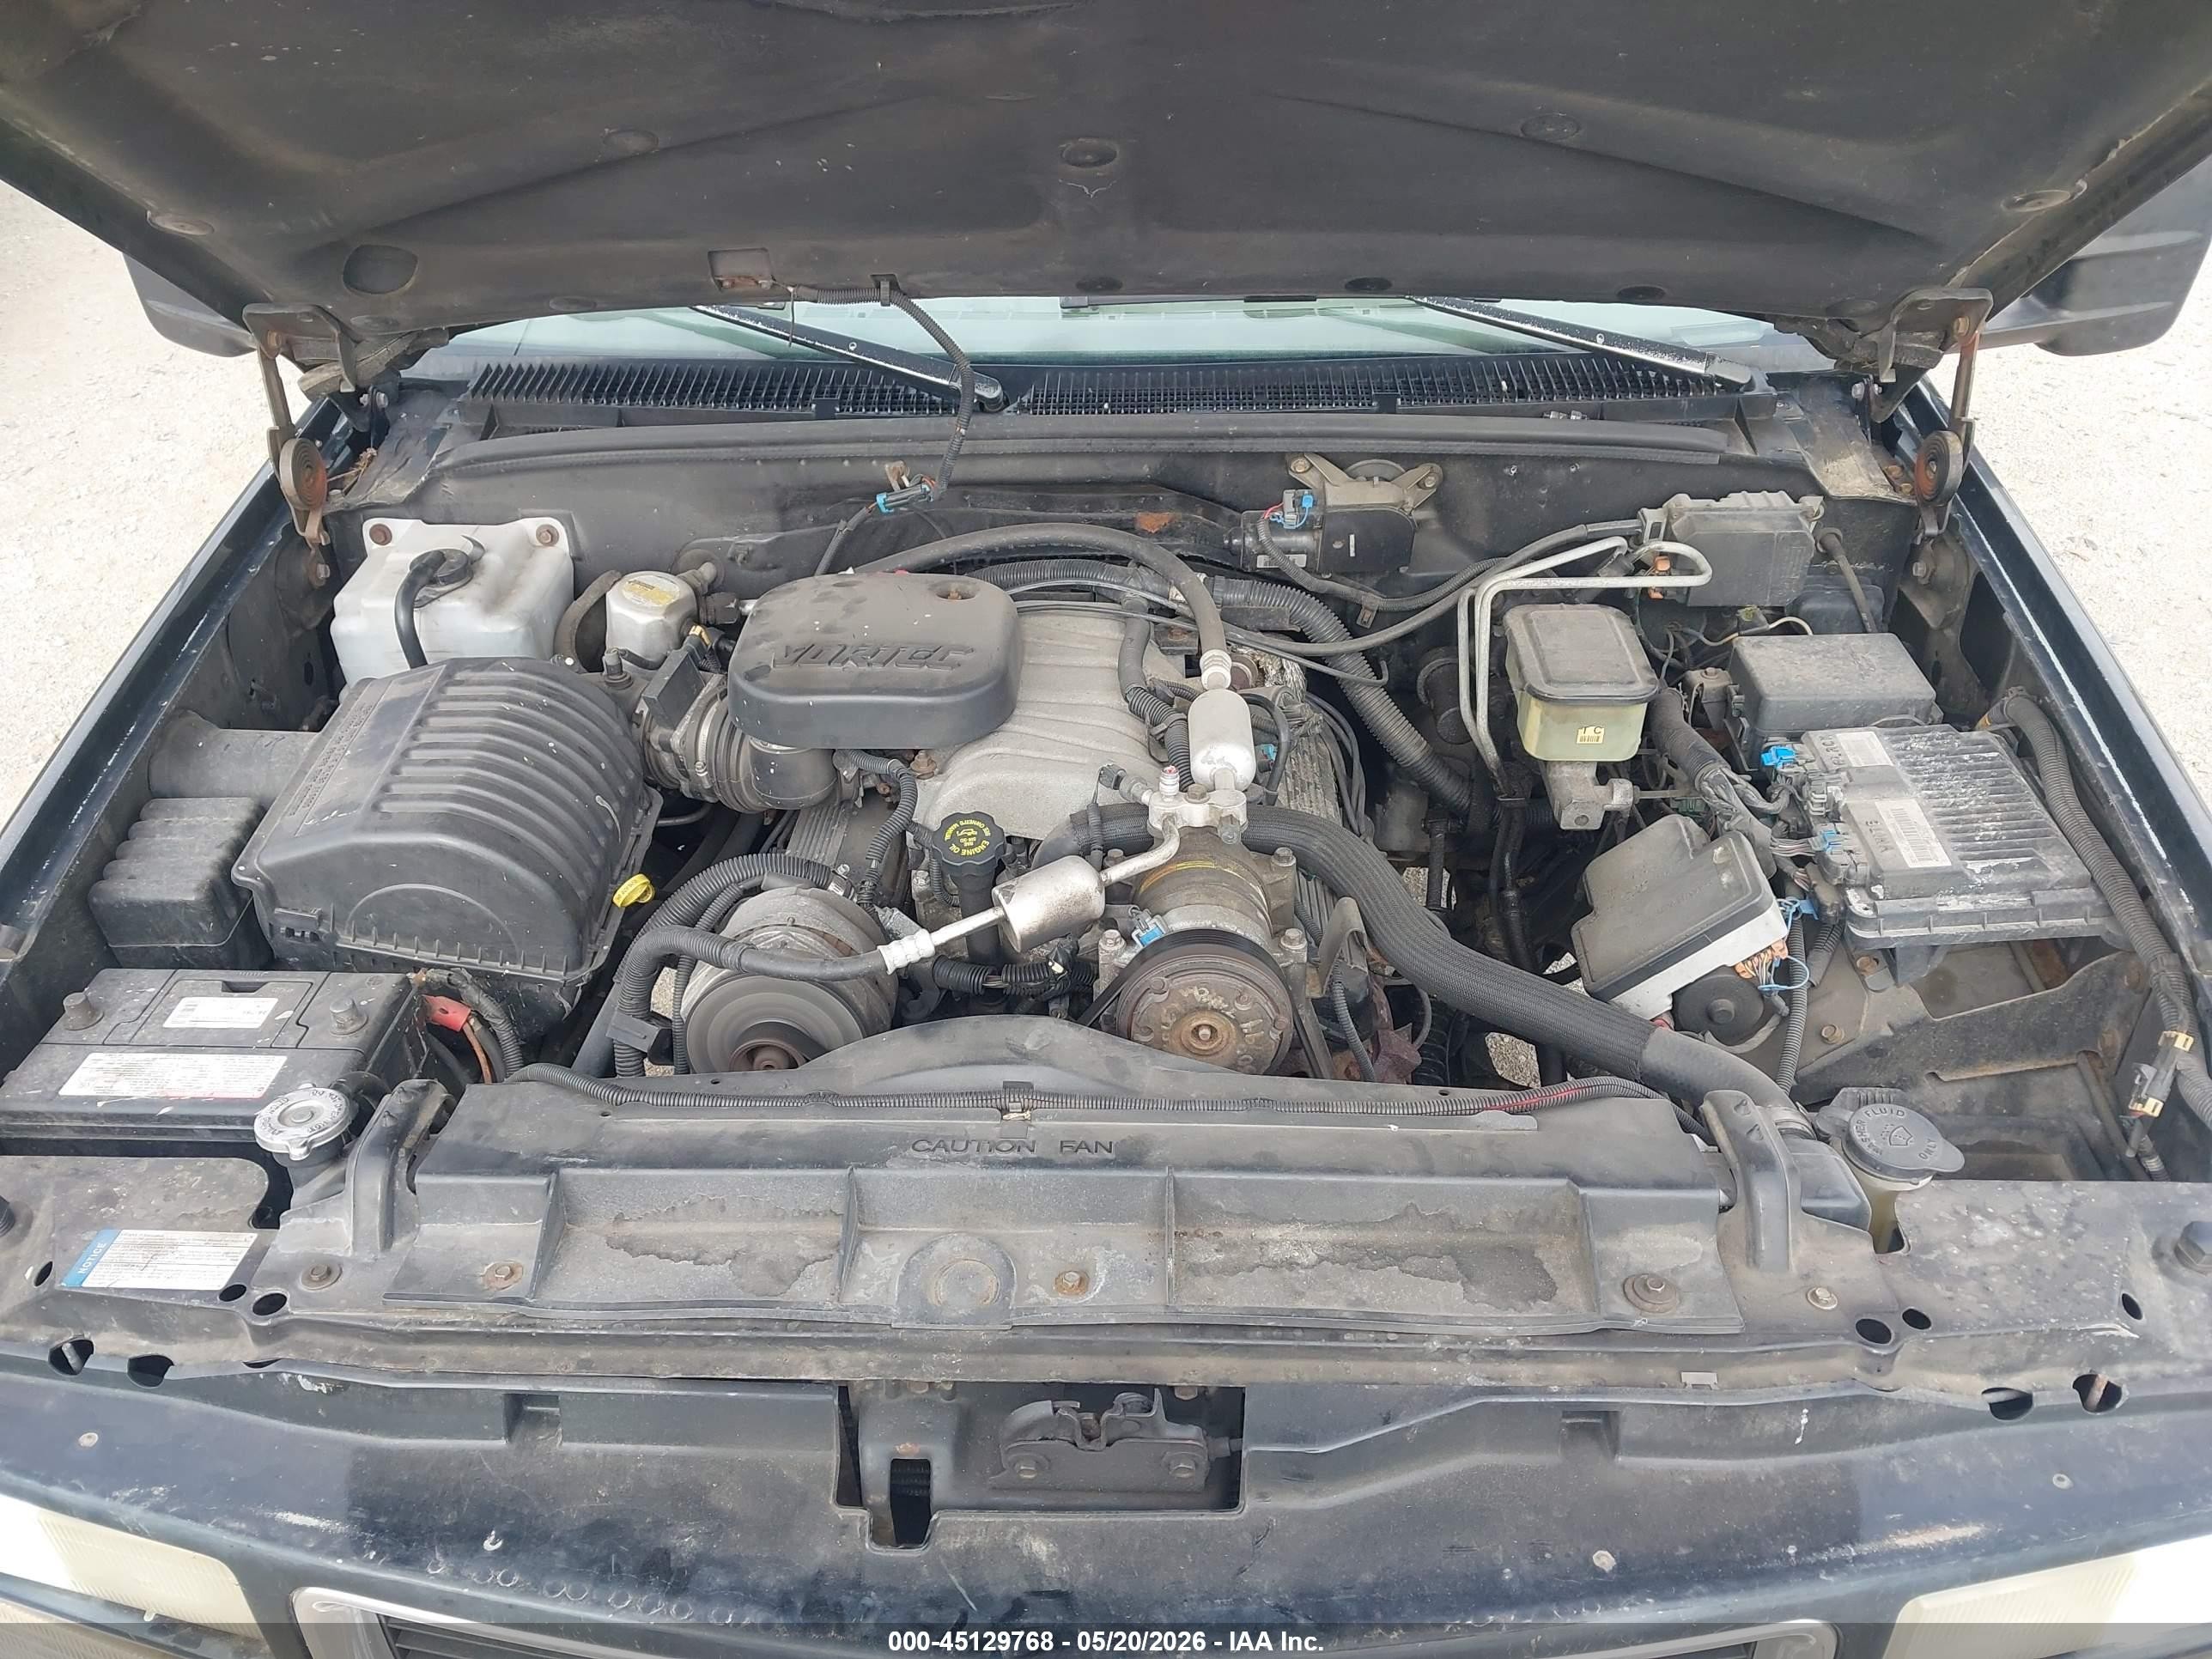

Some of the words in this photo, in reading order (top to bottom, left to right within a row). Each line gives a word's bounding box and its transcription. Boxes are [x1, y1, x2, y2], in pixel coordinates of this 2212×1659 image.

[949, 843, 961, 854] OIL
[961, 840, 990, 856] ENGINE
[1864, 1108, 1905, 1118] FLUID
[1855, 1118, 1883, 1156] WASHER
[911, 1139, 1036, 1154] CAUTION
[1060, 1140, 1115, 1154] FAN
[1917, 1138, 1939, 1161] ONLY
[77, 1242, 107, 1275] NOTICE
